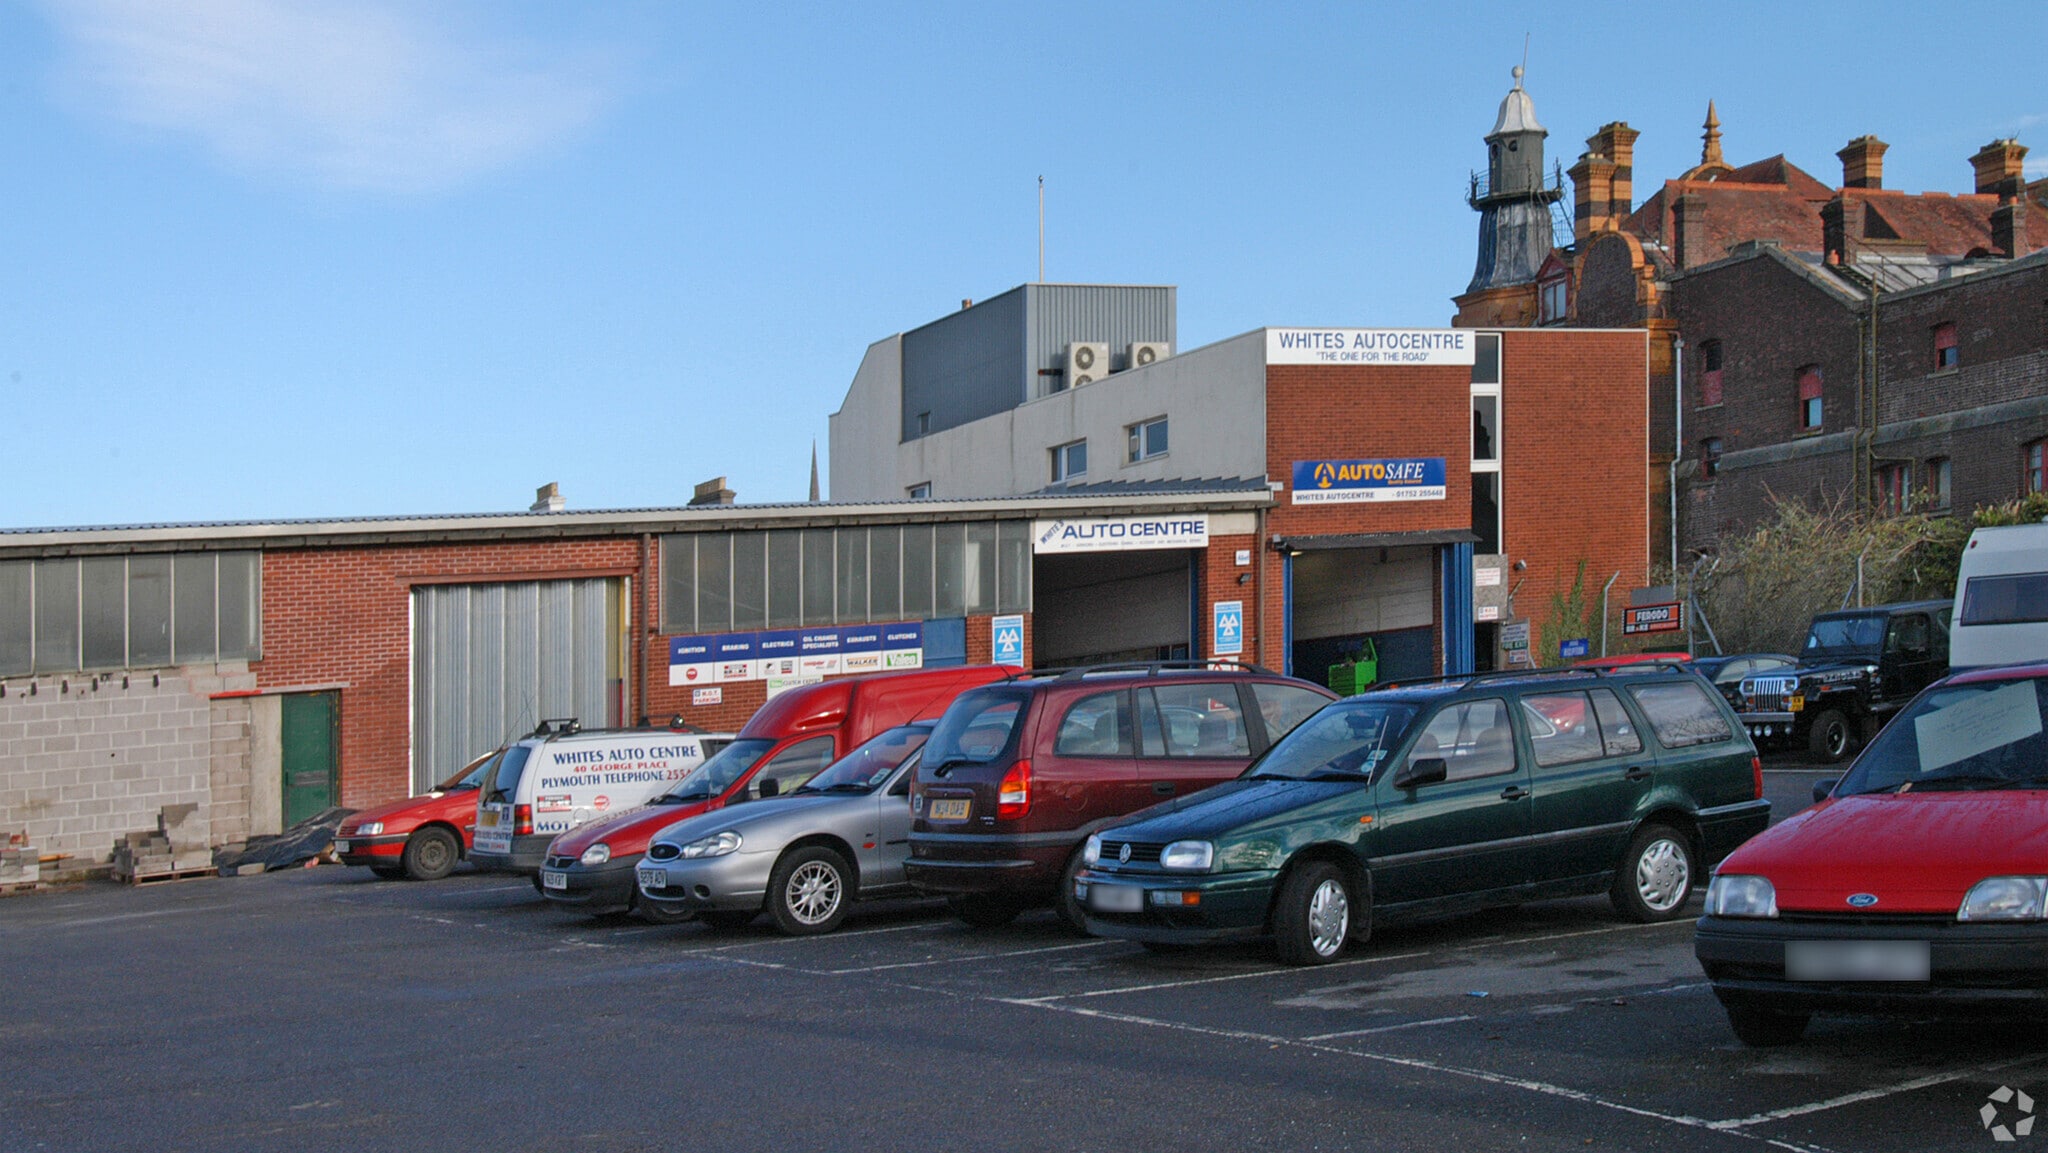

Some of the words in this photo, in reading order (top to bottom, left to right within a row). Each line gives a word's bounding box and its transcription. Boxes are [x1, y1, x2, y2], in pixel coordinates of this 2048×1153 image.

[1279, 332, 1345, 349] WHITES
[1353, 332, 1464, 349] AUTOCENTRE
[1340, 352, 1358, 361] ONE
[1361, 352, 1380, 361] FOR
[1383, 352, 1400, 361] THE
[1296, 493, 1324, 501] WHITES
[1326, 491, 1374, 500] AUTOCENTRE
[1396, 490, 1417, 498] 01752
[1062, 523, 1126, 539] AUTO
[1130, 520, 1204, 537] CENTRE
[1636, 609, 1669, 621] FERODO
[553, 749, 604, 765] WHITES
[609, 747, 645, 762] AUTO
[650, 745, 697, 759] CENTRE
[573, 765, 587, 773] 40
[591, 763, 633, 772] GEORGE
[637, 760, 668, 769] PLACE
[541, 774, 600, 789] PLYMOUTH
[605, 770, 664, 784] TELEPHONE
